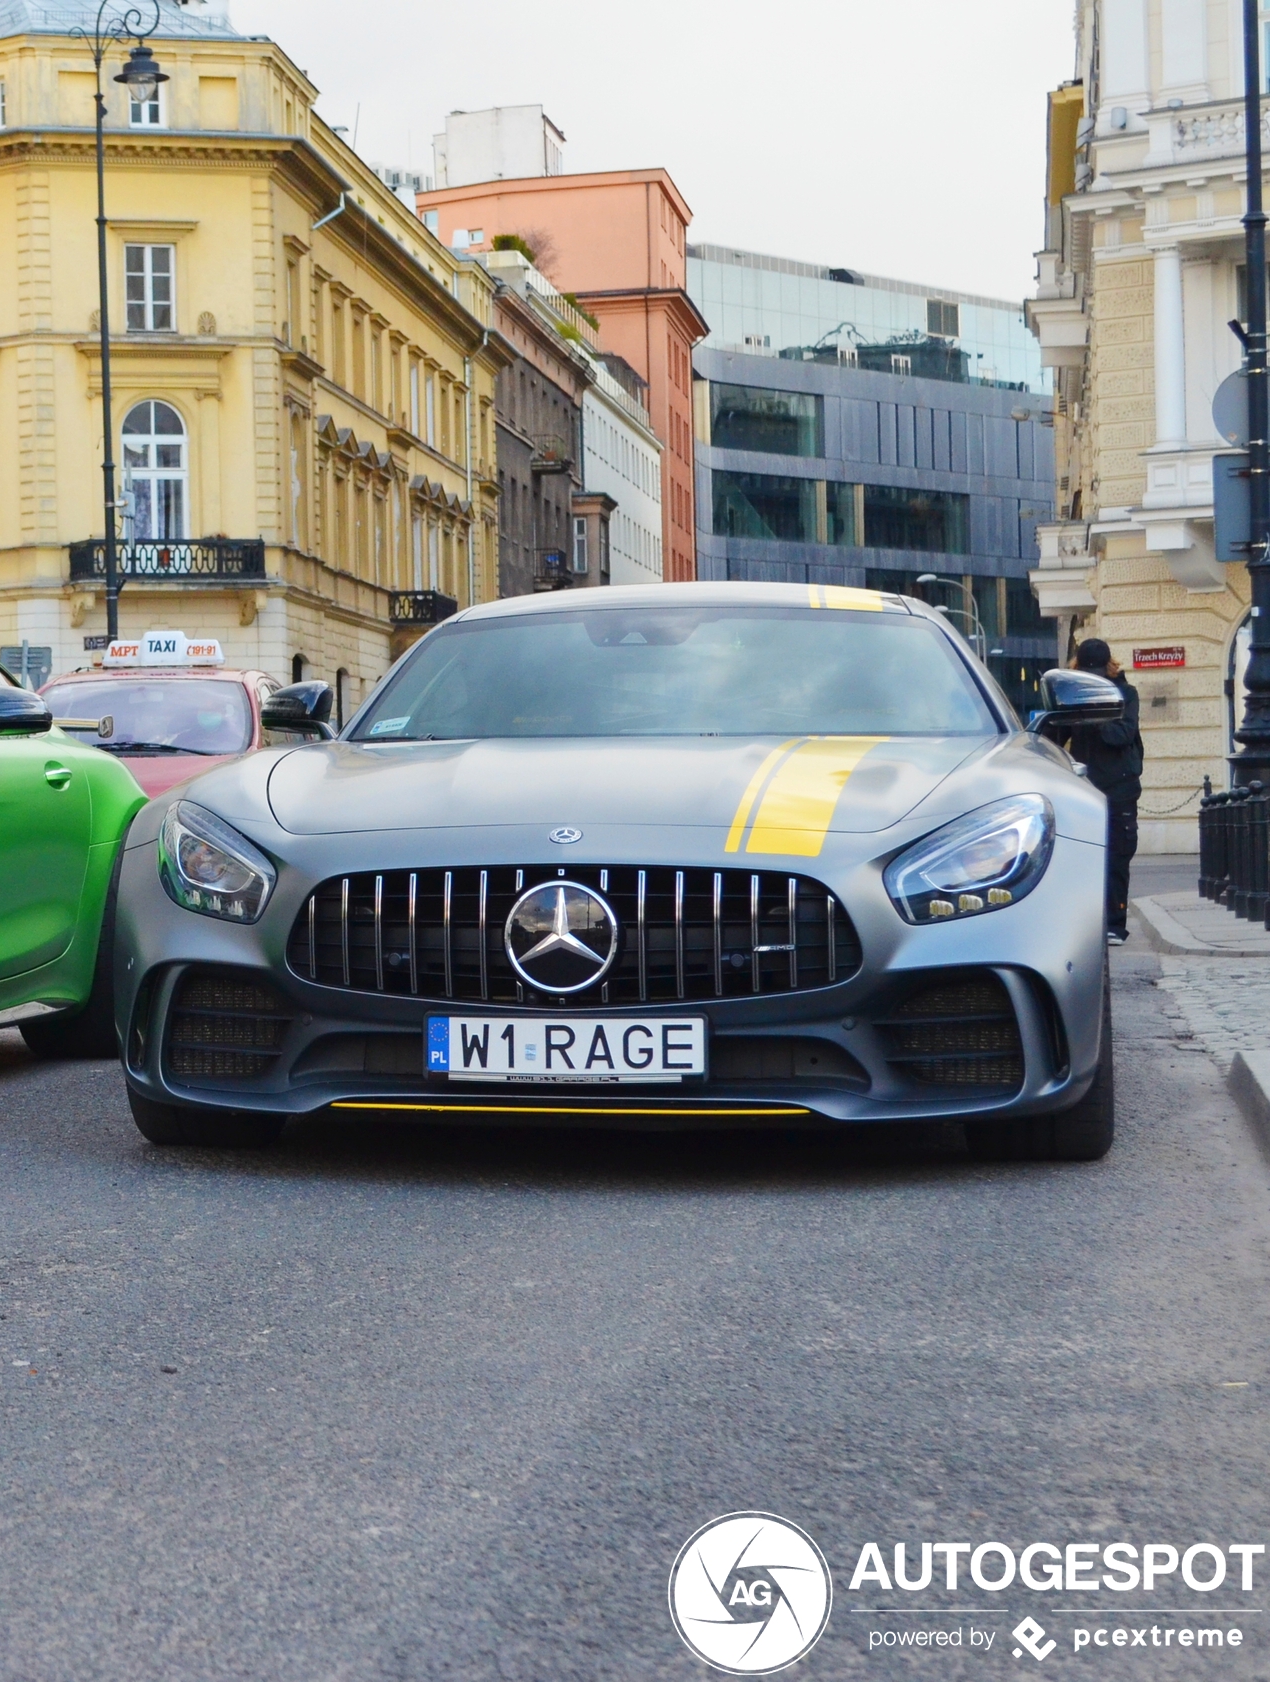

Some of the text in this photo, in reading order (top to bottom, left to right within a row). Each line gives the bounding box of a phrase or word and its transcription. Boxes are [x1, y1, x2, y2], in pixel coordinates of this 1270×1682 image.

[110, 646, 138, 657] MPT
[148, 640, 176, 653] TAXI
[1135, 651, 1158, 662] Trzech
[1159, 651, 1183, 662] Krzyży
[460, 1023, 693, 1069] W1 RAGE
[431, 1051, 447, 1063] PL
